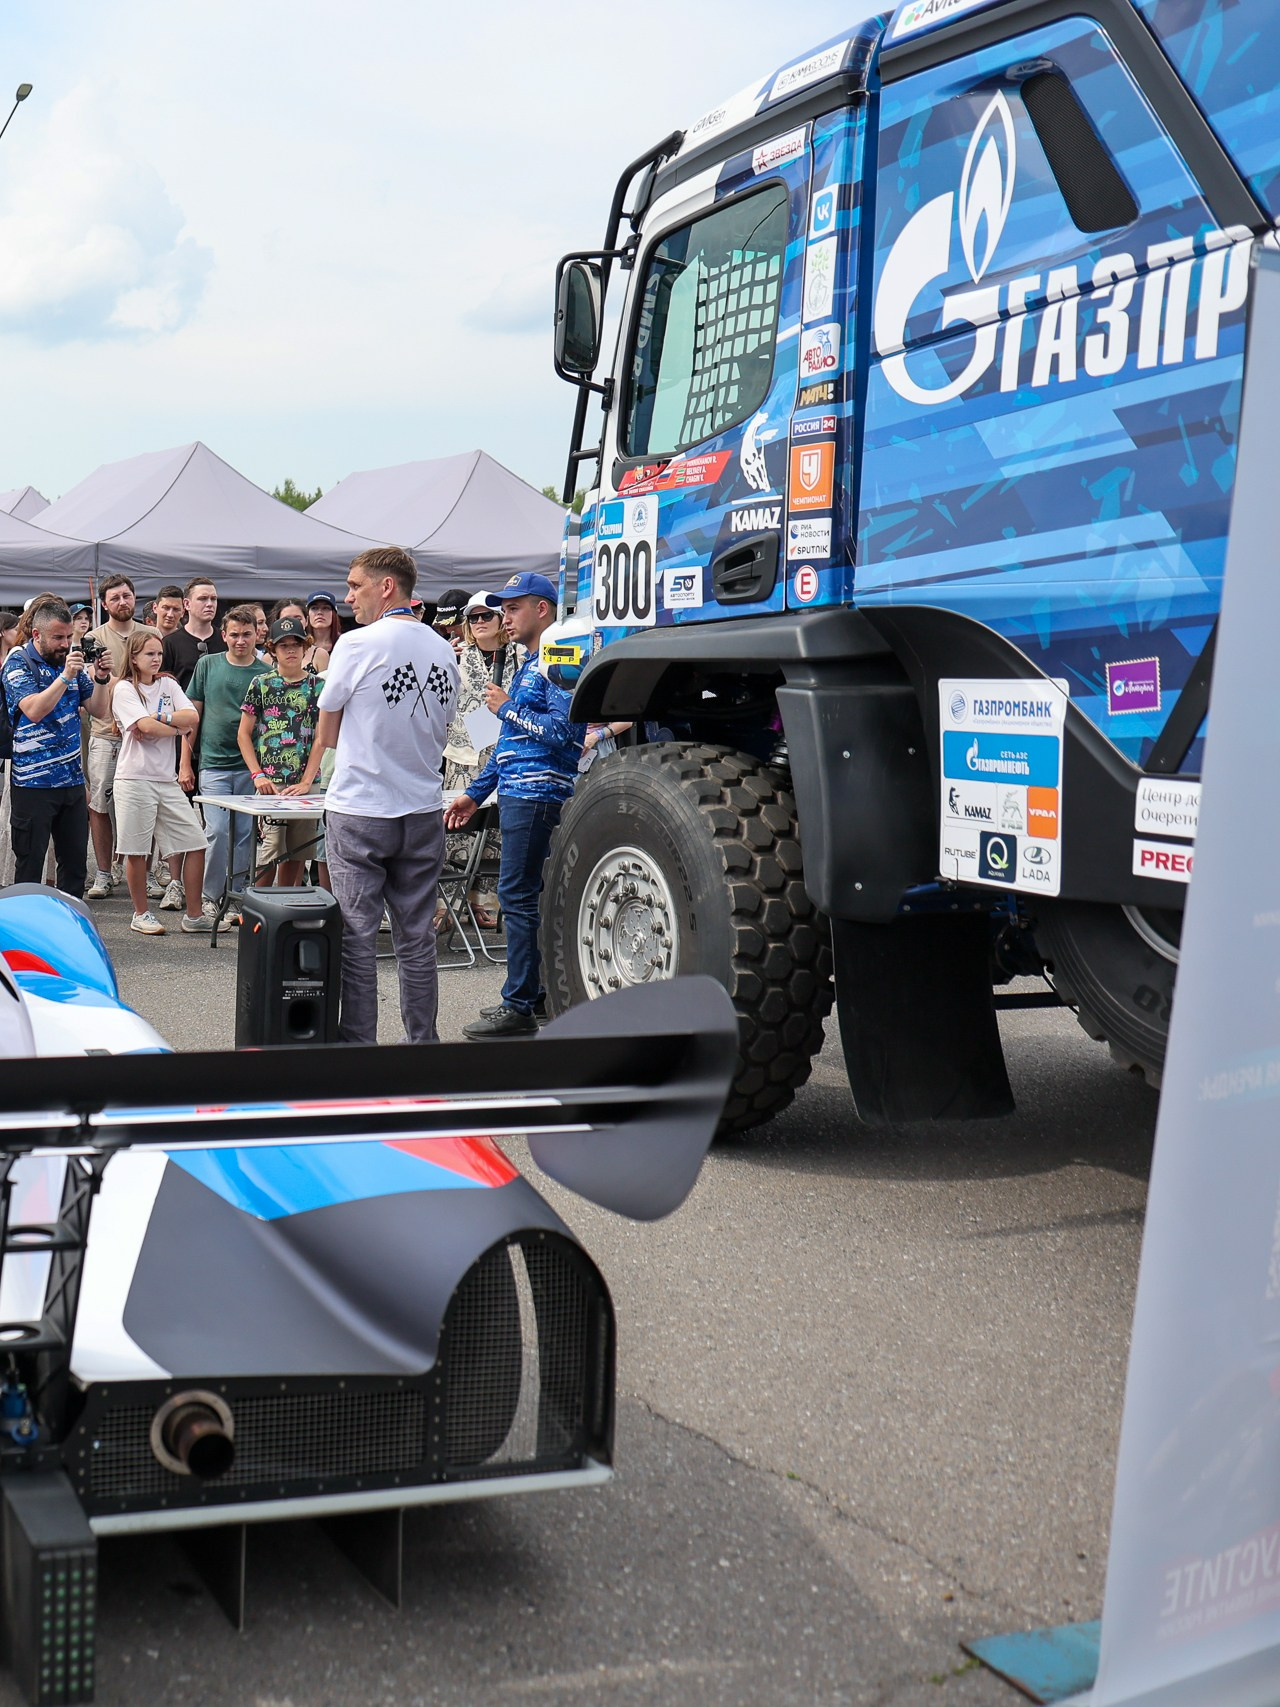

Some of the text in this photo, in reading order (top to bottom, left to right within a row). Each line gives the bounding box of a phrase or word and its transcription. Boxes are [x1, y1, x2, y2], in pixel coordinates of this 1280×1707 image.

[769, 139, 802, 162] ЗВЕЗДА
[1000, 217, 1280, 393] ГАЗПР
[803, 345, 822, 362] АВТО
[808, 354, 836, 374] РАДИО
[794, 418, 835, 434] РОССИЯ 24
[792, 494, 827, 506] ЧЕМПИОНАТ
[731, 506, 782, 533] KAMAZ
[800, 530, 830, 538] НОВОСТИ
[797, 544, 828, 555] SPUTNIK
[596, 540, 652, 620] 300
[800, 573, 812, 595] E
[973, 700, 1053, 718] ГАЗПРОМБАНК
[505, 708, 544, 736] master
[1000, 751, 1028, 760] СЕТЬ АЗС
[1142, 788, 1182, 809] Центр
[965, 805, 992, 820] KAMAZ
[944, 847, 977, 860] RUTUBE
[1022, 868, 1051, 883] LADA
